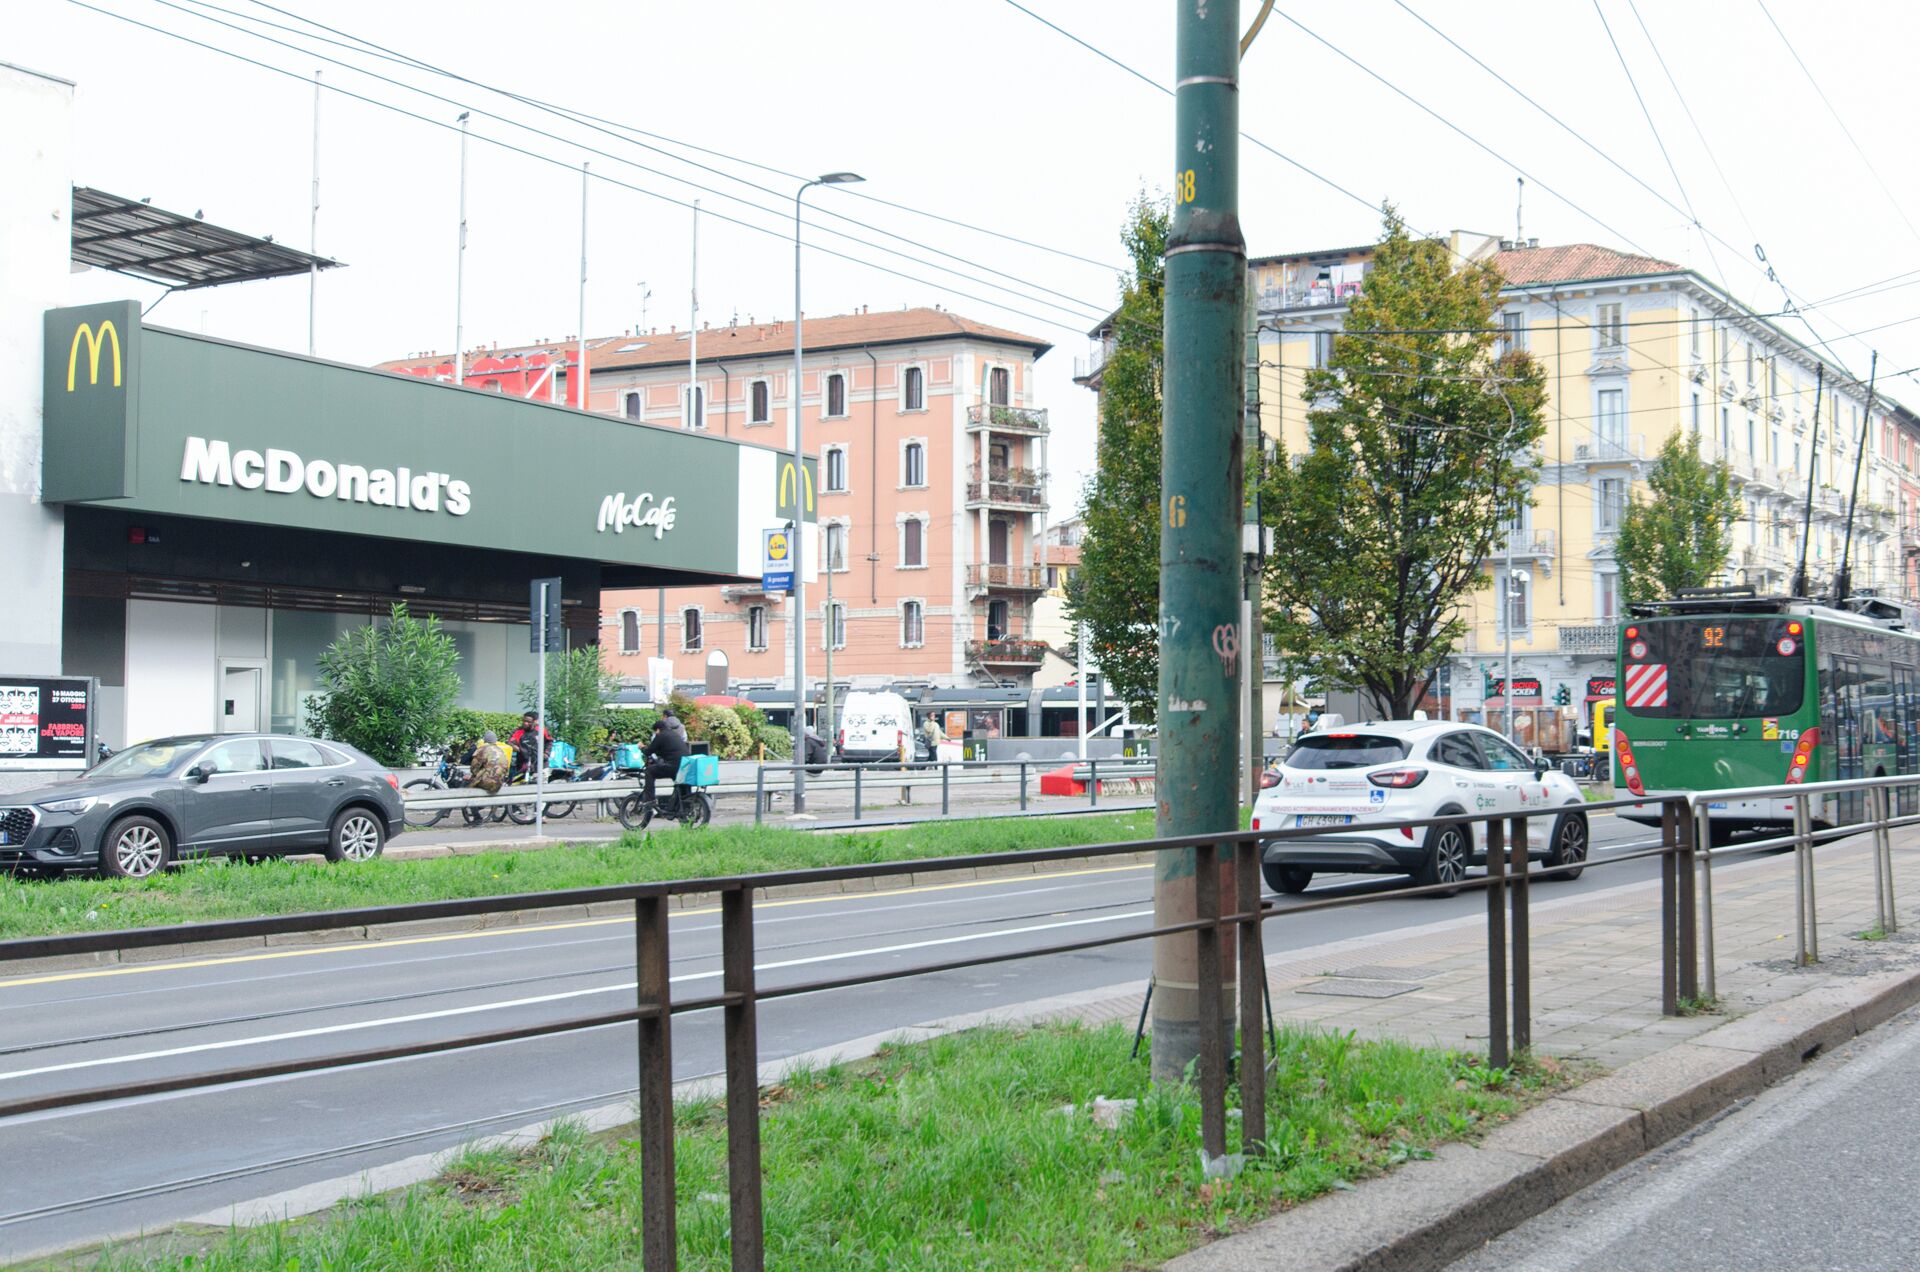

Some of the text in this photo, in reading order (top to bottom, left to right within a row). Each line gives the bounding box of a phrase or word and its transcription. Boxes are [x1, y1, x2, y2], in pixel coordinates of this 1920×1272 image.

[1176, 169, 1196, 205] 68
[180, 436, 471, 516] McDonald's
[596, 492, 677, 540] McCafé
[1703, 627, 1725, 647] 92
[55, 729, 84, 737] VAPORE
[1777, 729, 1799, 739] 716
